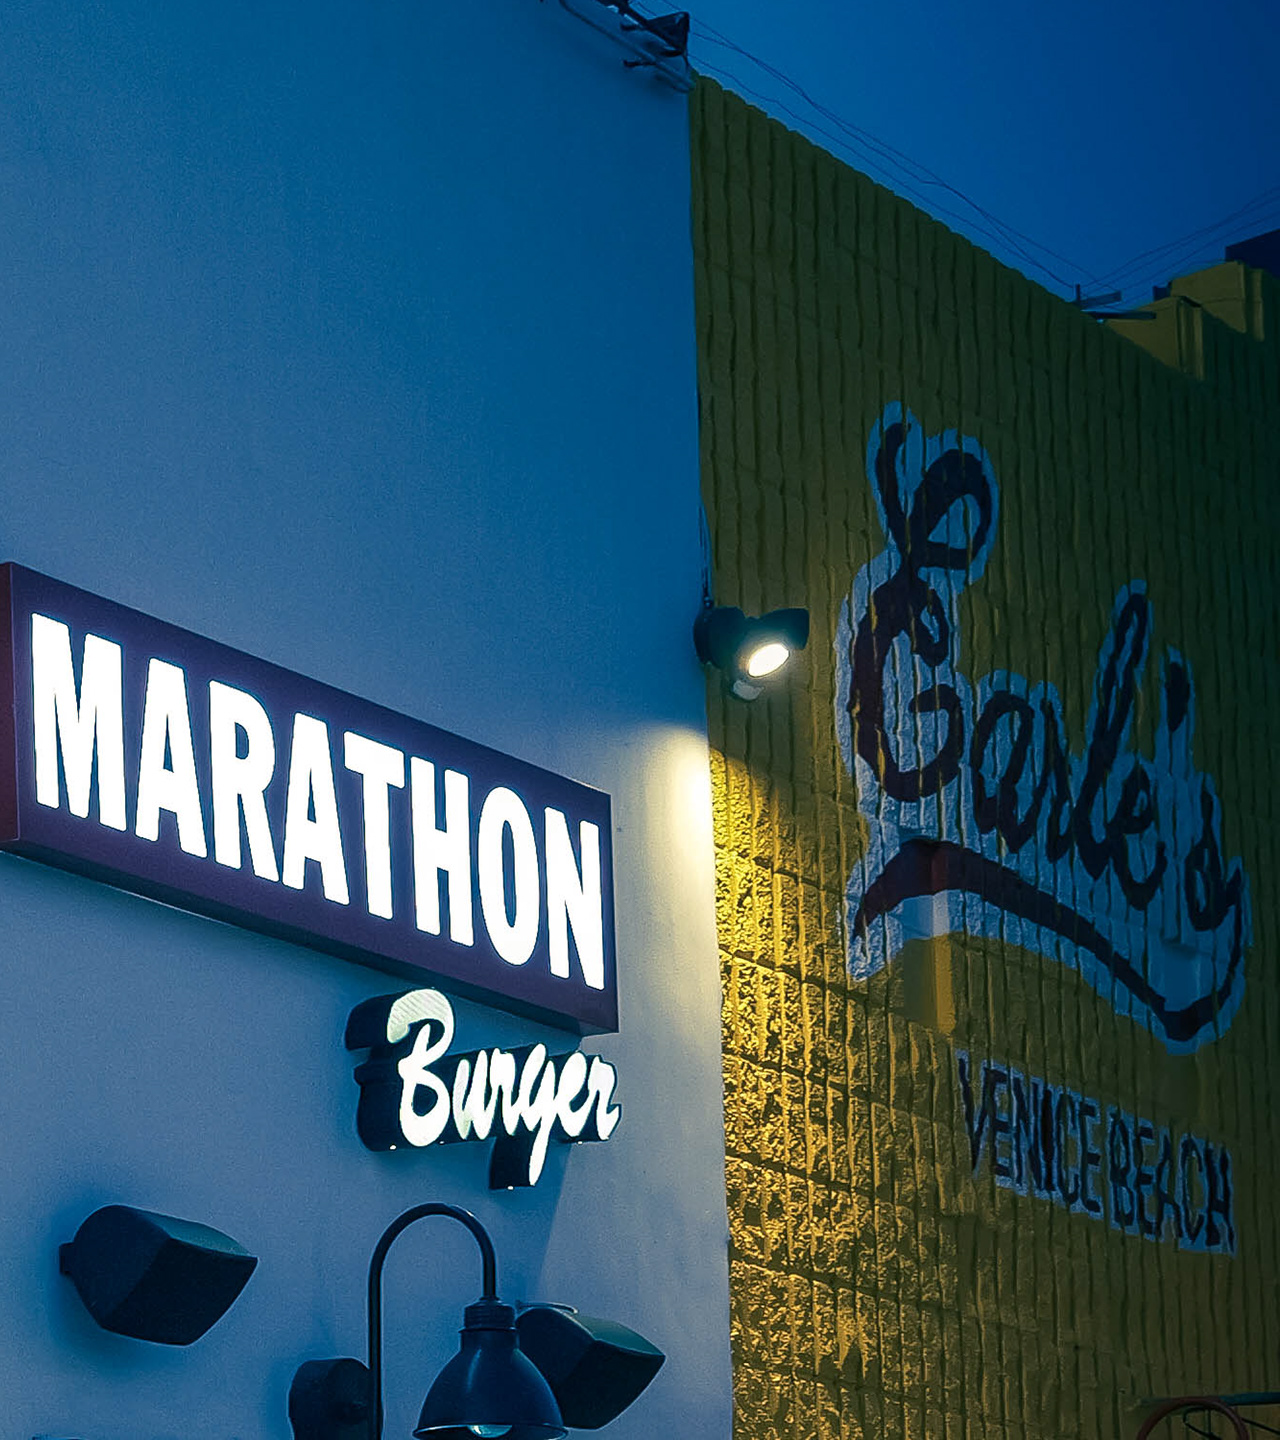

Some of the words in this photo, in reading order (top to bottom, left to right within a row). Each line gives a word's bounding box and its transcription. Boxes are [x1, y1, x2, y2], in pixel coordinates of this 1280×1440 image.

[31, 612, 605, 991] MARATHON
[850, 420, 1241, 934] Earl's
[387, 988, 622, 1185] Burger
[958, 1052, 1104, 1215] VENICE
[1109, 1108, 1235, 1254] BEACH
